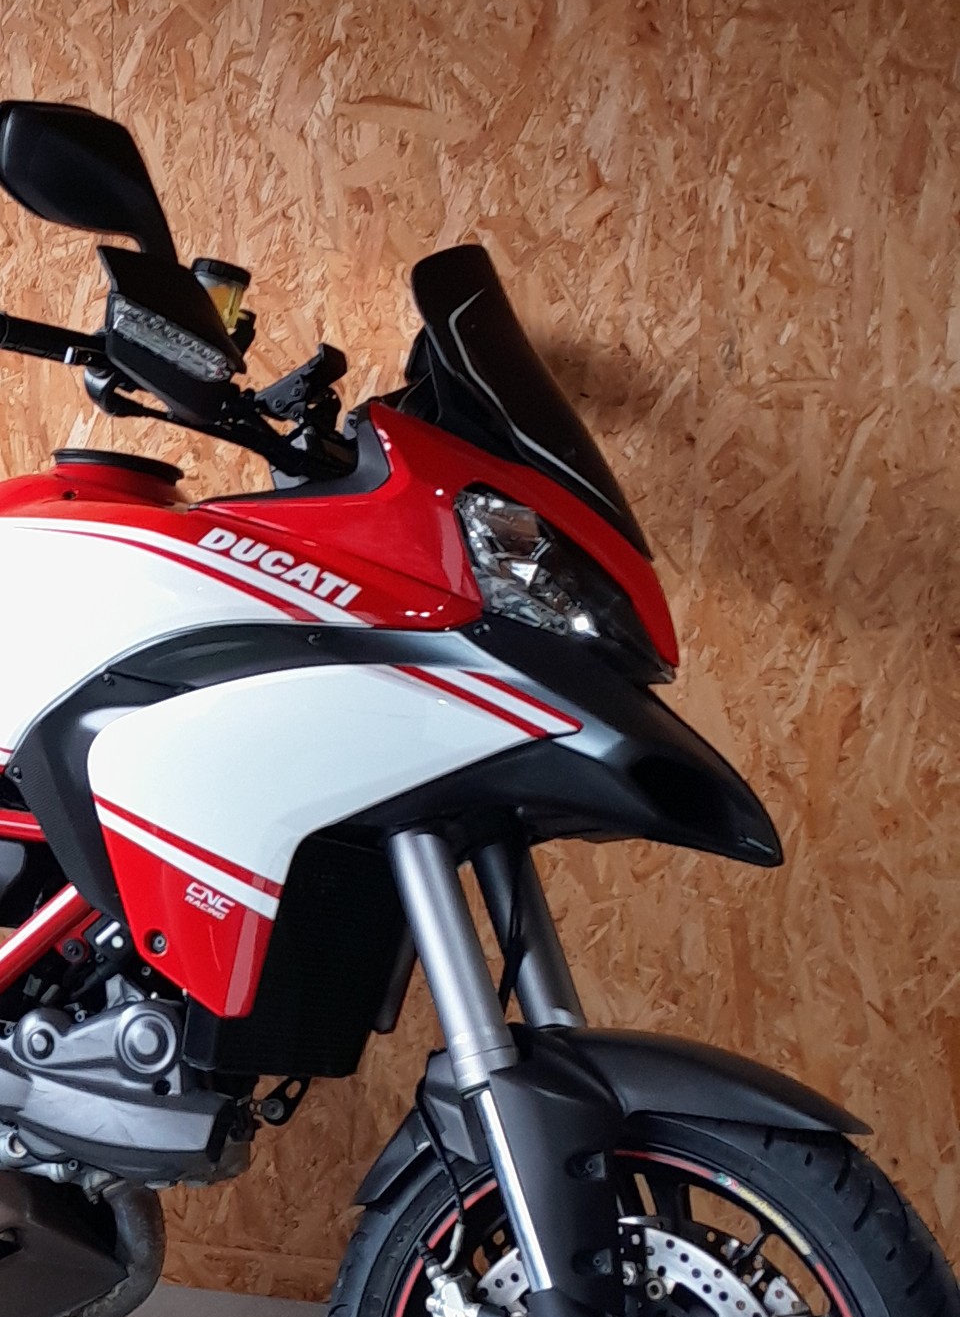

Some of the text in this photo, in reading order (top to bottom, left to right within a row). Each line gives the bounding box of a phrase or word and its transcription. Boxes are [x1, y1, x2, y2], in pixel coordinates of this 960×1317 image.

[197, 527, 362, 607] DUCATI
[184, 895, 227, 921] RACING
[186, 882, 235, 913] CNC
